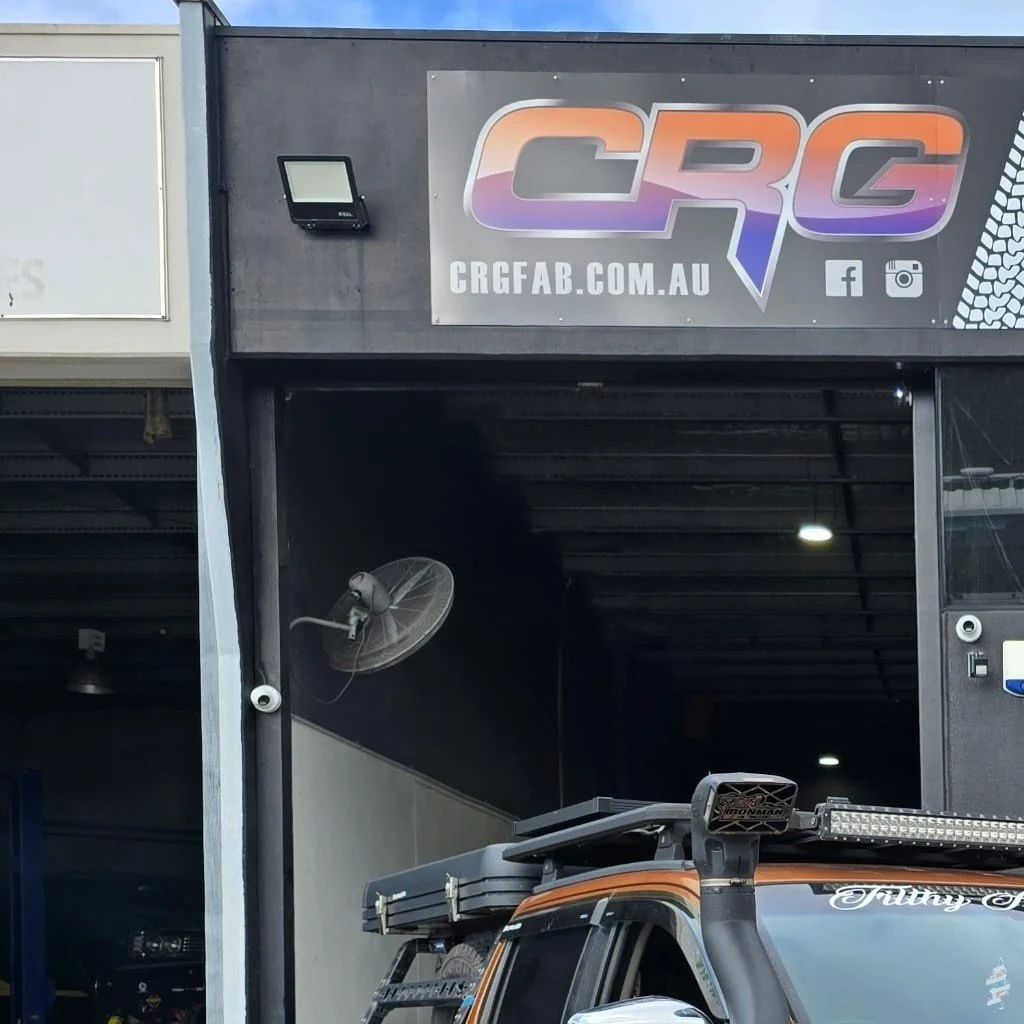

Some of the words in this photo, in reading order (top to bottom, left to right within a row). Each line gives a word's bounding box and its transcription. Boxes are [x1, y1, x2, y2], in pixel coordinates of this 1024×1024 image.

[463, 98, 970, 312] CRG
[449, 260, 711, 297] CRGFAB.COM.AU
[829, 885, 971, 912] Filthy
